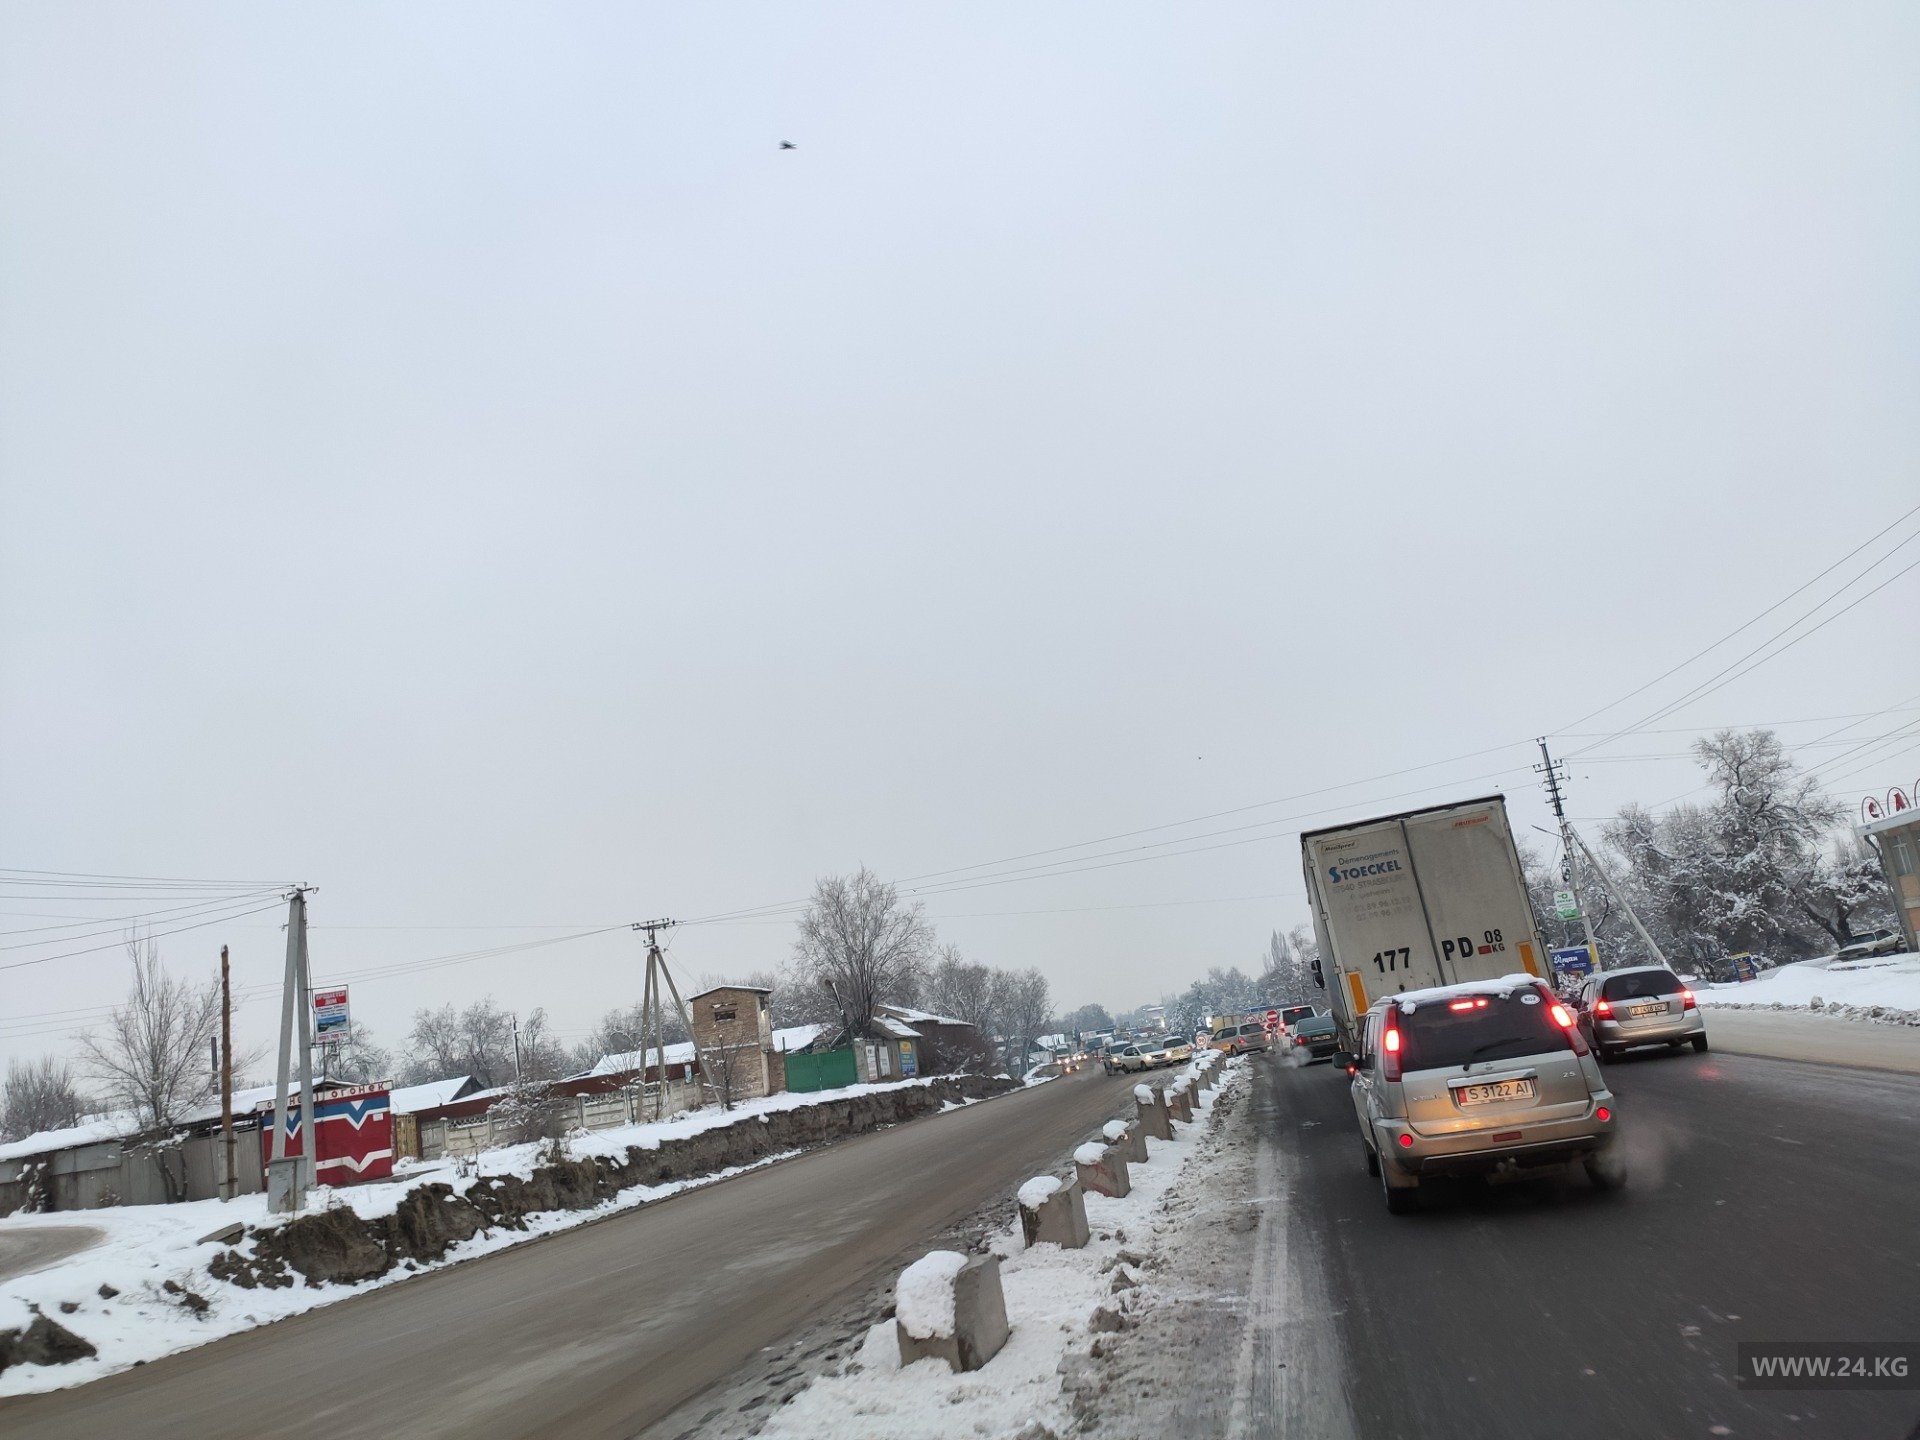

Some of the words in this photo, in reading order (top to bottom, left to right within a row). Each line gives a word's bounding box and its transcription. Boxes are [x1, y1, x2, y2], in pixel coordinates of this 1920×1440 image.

[1328, 860, 1402, 883] STOECKEL
[1373, 946, 1411, 973] 177
[1441, 936, 1474, 961] PD
[1484, 929, 1503, 944] 08
[1491, 943, 1506, 953] KG
[1516, 1082, 1529, 1095] AI
